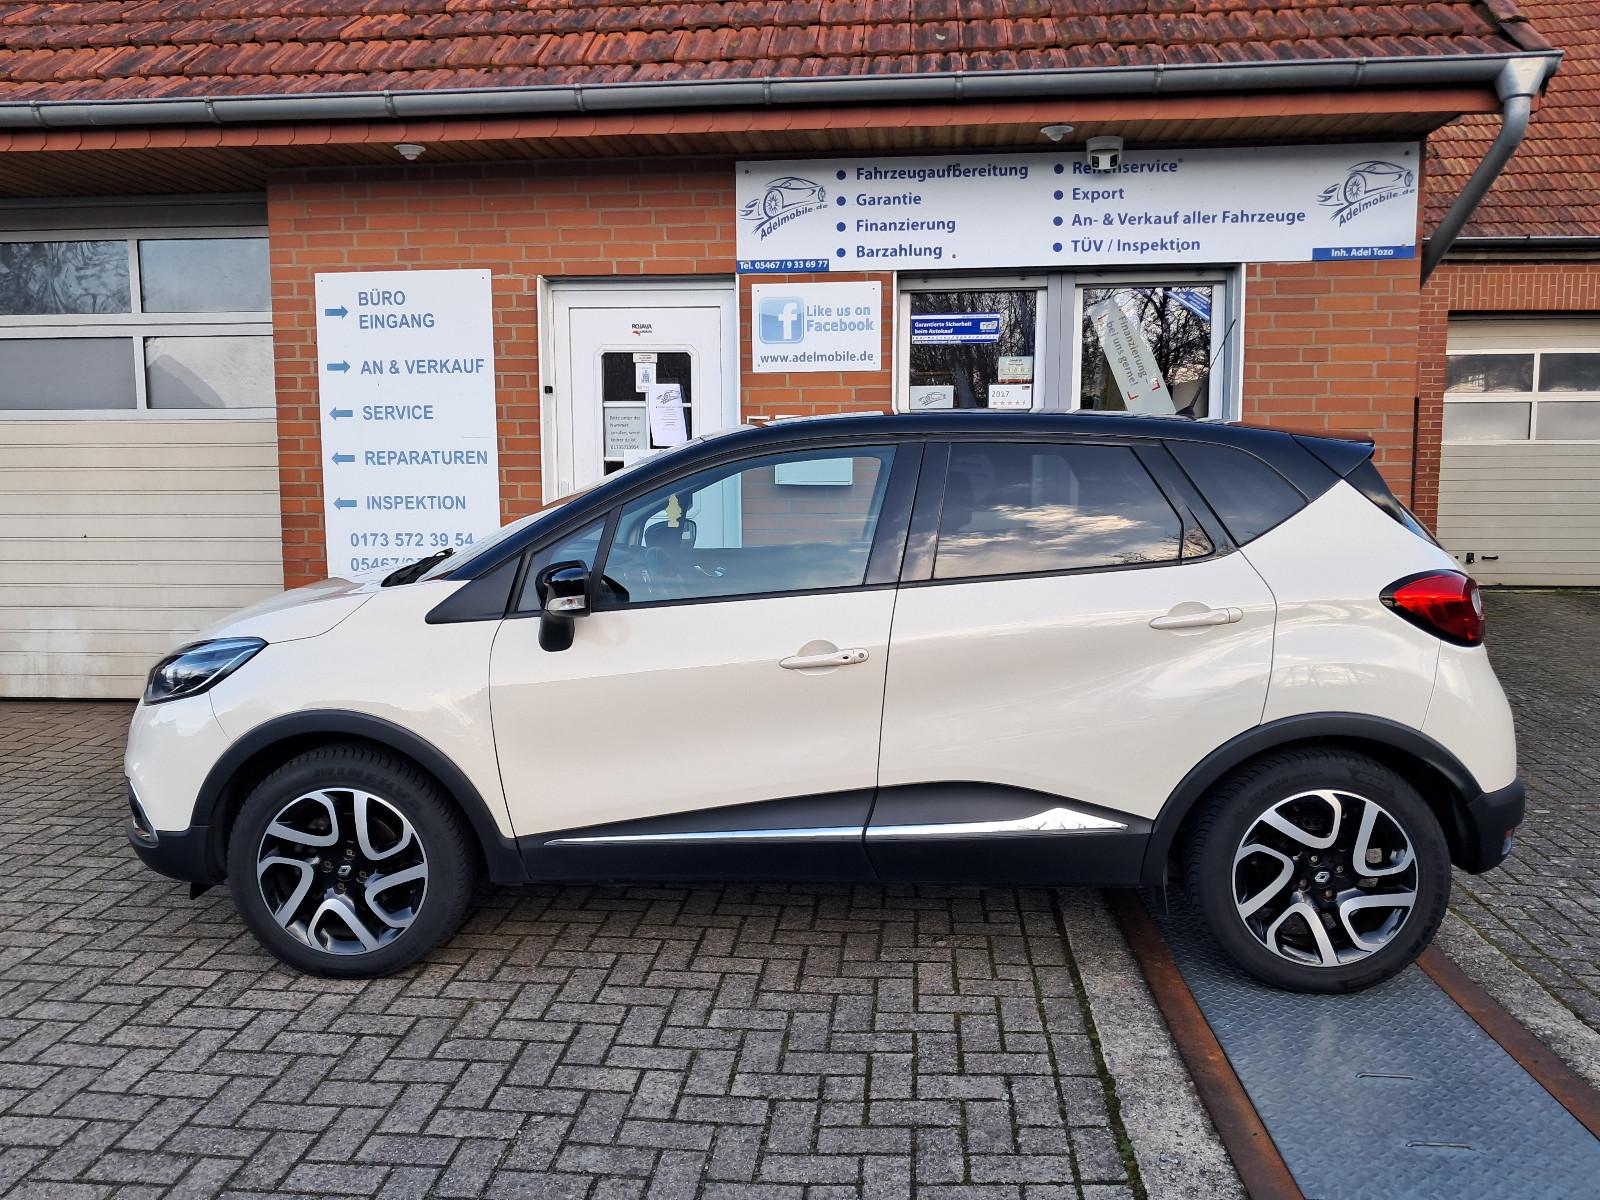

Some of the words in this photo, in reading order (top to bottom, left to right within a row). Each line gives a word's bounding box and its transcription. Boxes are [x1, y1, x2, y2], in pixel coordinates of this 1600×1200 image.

[856, 163, 1029, 183] Fahrzeugaufbereitung
[856, 193, 922, 207] Garantie
[1072, 187, 1125, 203] Export
[1339, 188, 1415, 227] Adelmobile.de
[760, 203, 829, 240] Adelmobile.de
[856, 218, 956, 233] Finanzierung
[1072, 213, 1099, 226] An-
[1102, 212, 1115, 226] &
[1118, 211, 1179, 226] Verkauf
[1183, 210, 1220, 224] aller
[1222, 209, 1306, 226] Fahrzeuge
[856, 244, 943, 260] Barzahlung
[1072, 236, 1103, 252] TÜV
[1117, 238, 1201, 254] Inspektion
[1331, 248, 1349, 257] Inh.
[1351, 248, 1371, 256] Adel
[1373, 248, 1394, 256] Tozo
[740, 262, 753, 270] Tel.
[819, 260, 828, 268] 77
[358, 288, 406, 306] BÜRO
[807, 305, 832, 317] Like
[837, 306, 851, 316] us
[855, 306, 871, 316] on
[359, 313, 435, 329] EINGANG
[806, 318, 874, 332] Facebook
[1117, 315, 1147, 379] Finanzierung
[760, 350, 874, 363] www.adelmobile.de
[360, 359, 384, 375] AN
[388, 359, 400, 375] &
[405, 358, 485, 374] VERKAUF
[362, 405, 434, 421] SERVICE
[364, 450, 488, 465] REPARATUREN
[366, 495, 466, 510] INSPEKTION
[350, 532, 389, 547] 0173
[395, 532, 424, 547] 572
[430, 532, 449, 547] 39
[455, 532, 475, 547] 54
